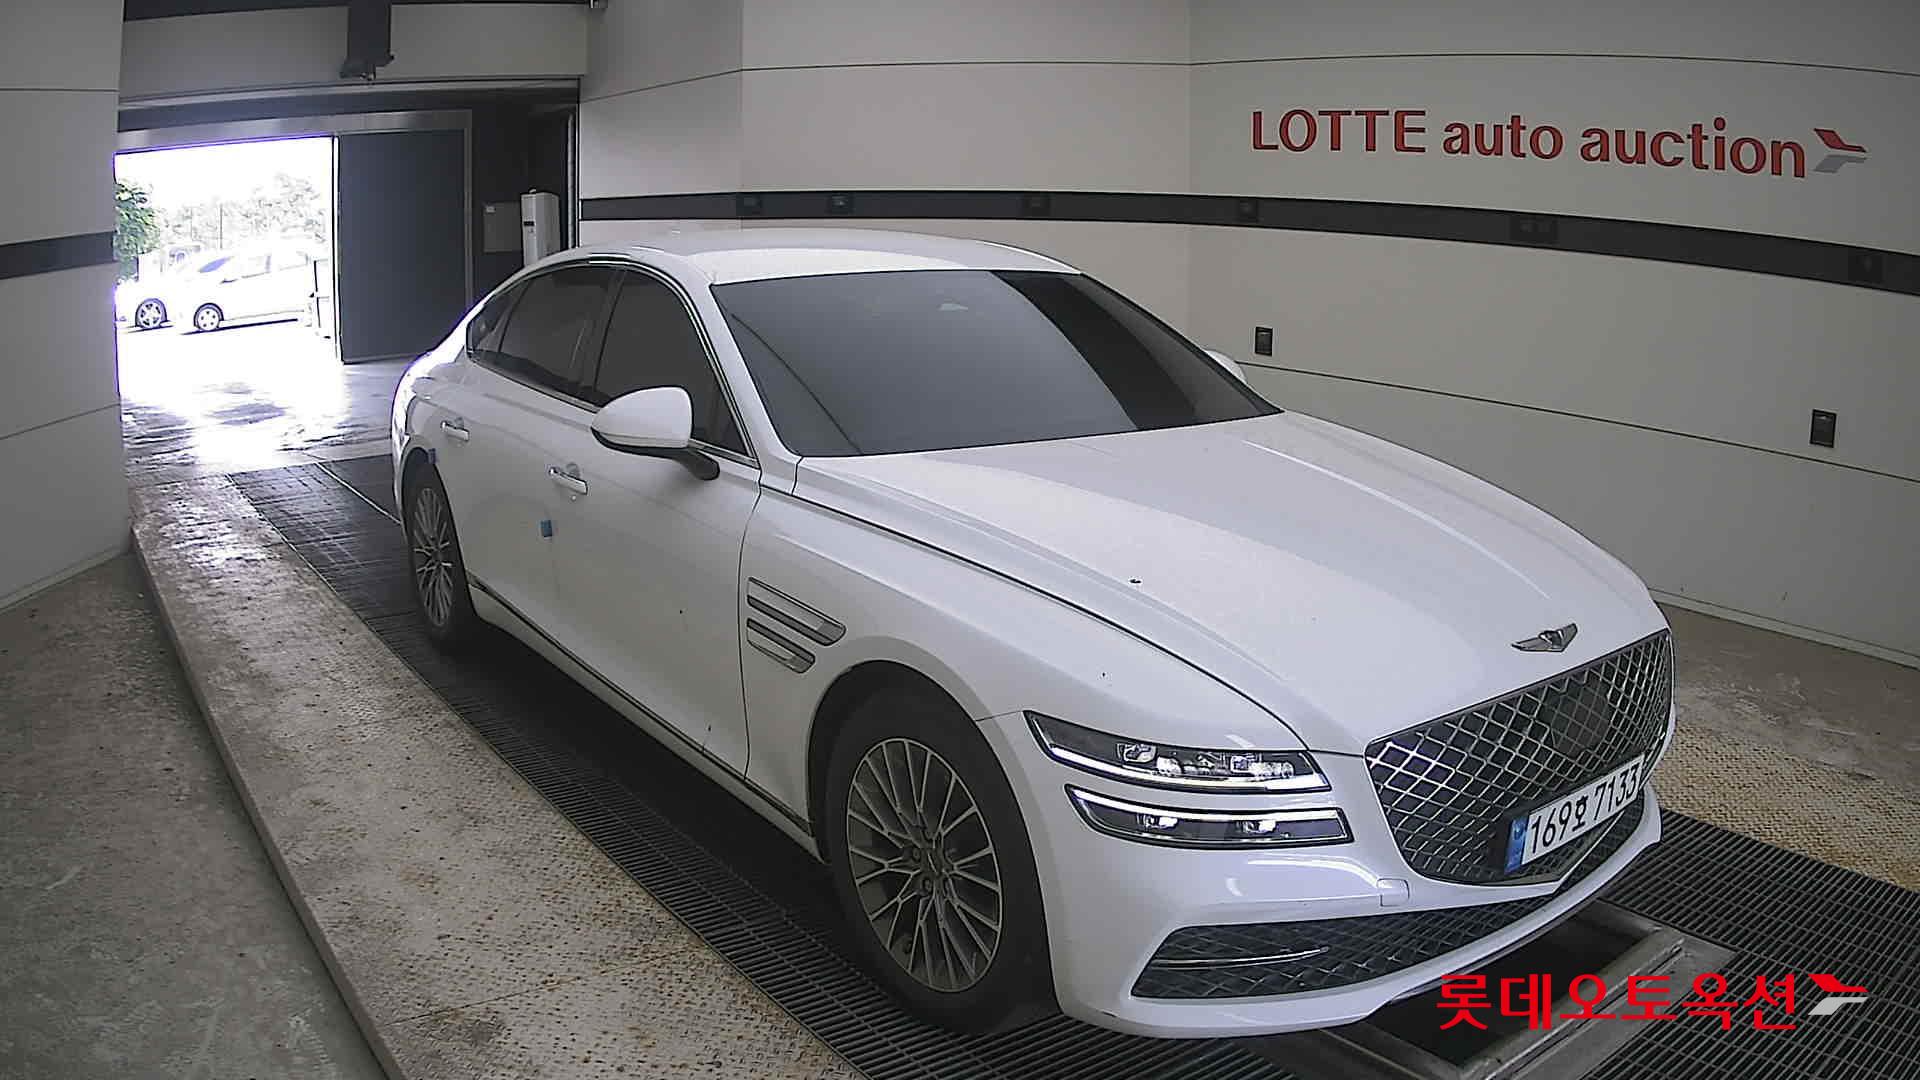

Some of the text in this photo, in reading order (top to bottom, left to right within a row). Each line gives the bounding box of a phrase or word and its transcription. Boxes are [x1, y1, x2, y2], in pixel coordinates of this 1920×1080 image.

[1252, 109, 1806, 179] LOTTE auto auction
[1531, 795, 1589, 854] 169호
[1594, 763, 1641, 821] 7133
